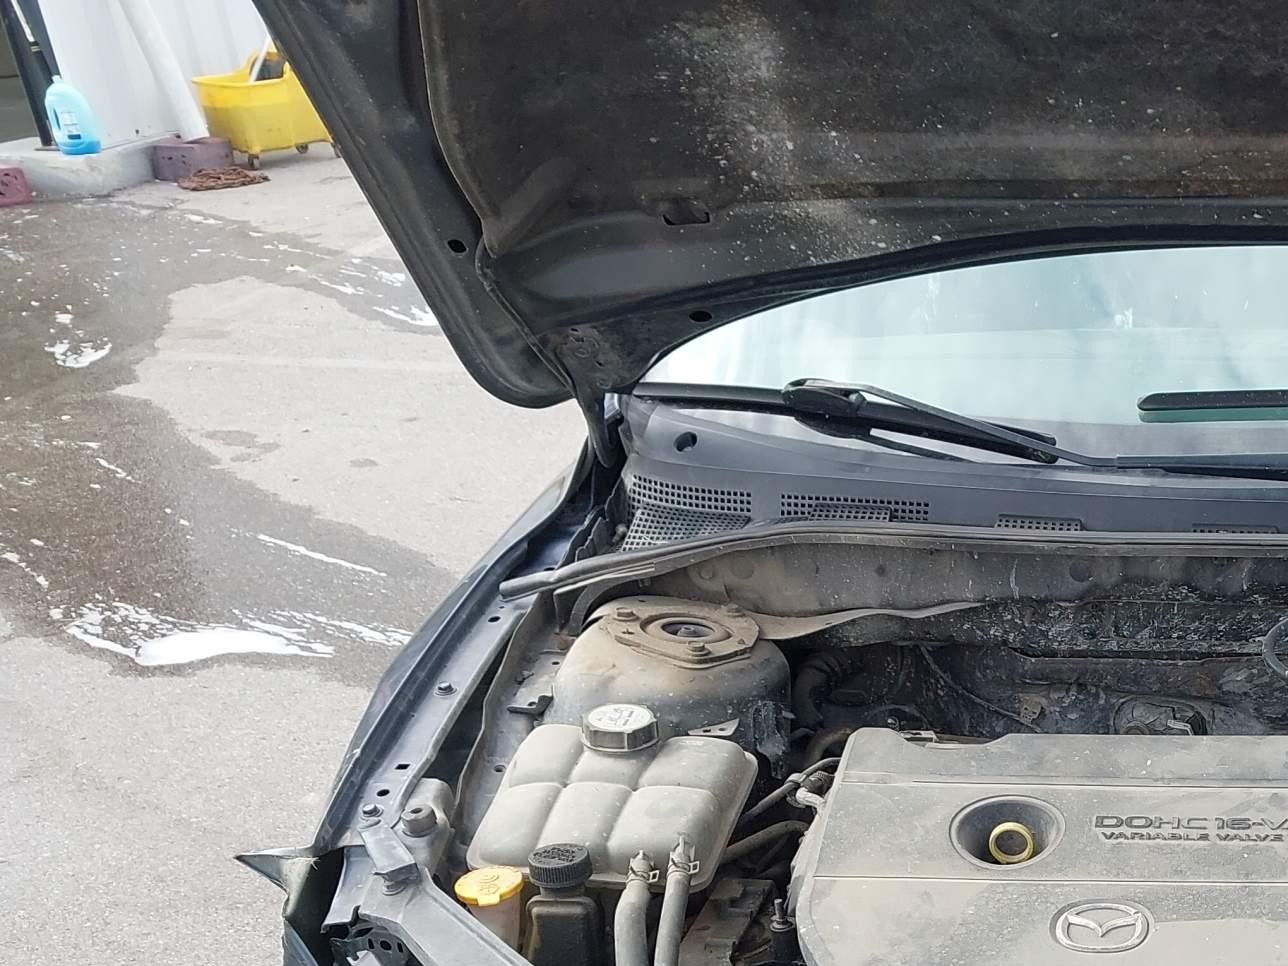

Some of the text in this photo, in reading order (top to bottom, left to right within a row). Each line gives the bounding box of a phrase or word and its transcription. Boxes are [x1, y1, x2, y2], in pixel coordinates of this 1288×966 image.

[1095, 815, 1208, 830] DOHC
[1101, 831, 1210, 841] VARIABLE
[1215, 833, 1284, 842] VALVE
